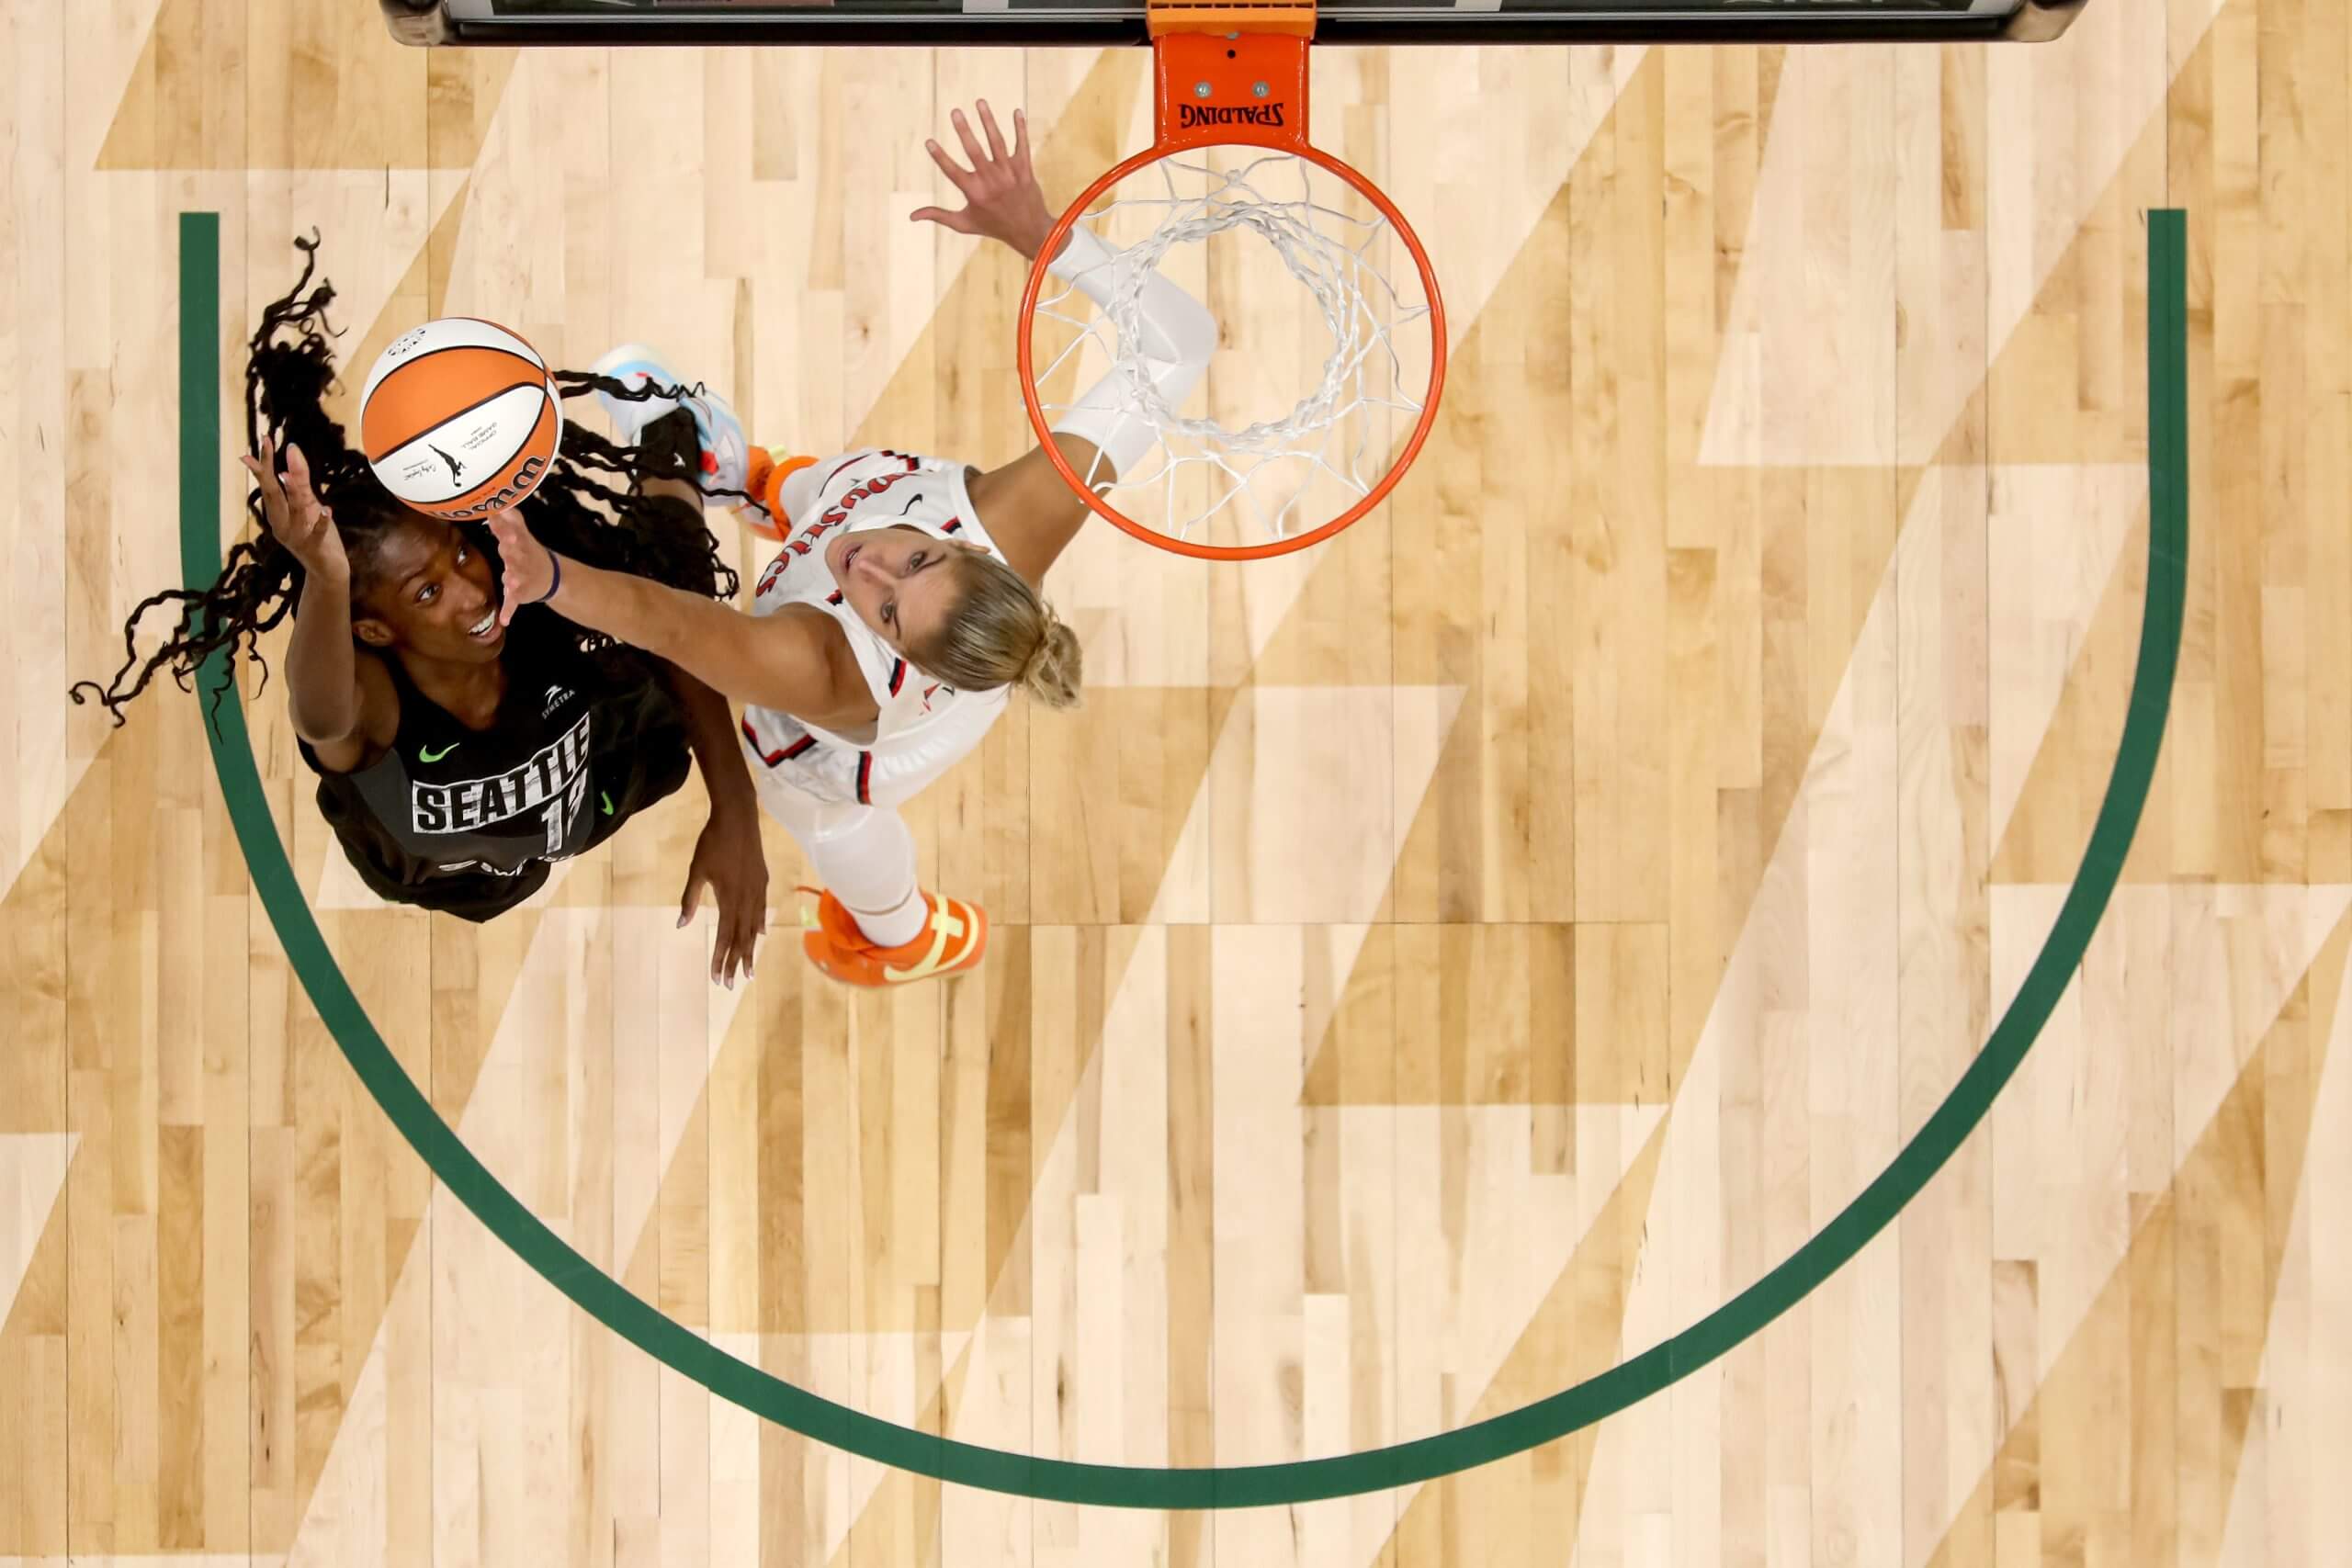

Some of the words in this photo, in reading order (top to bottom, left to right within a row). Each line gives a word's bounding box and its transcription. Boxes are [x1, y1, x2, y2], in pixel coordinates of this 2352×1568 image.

[1180, 103, 1283, 129] SPALDING
[541, 688, 576, 720] SYMETRA
[416, 720, 589, 830] SEATTLE
